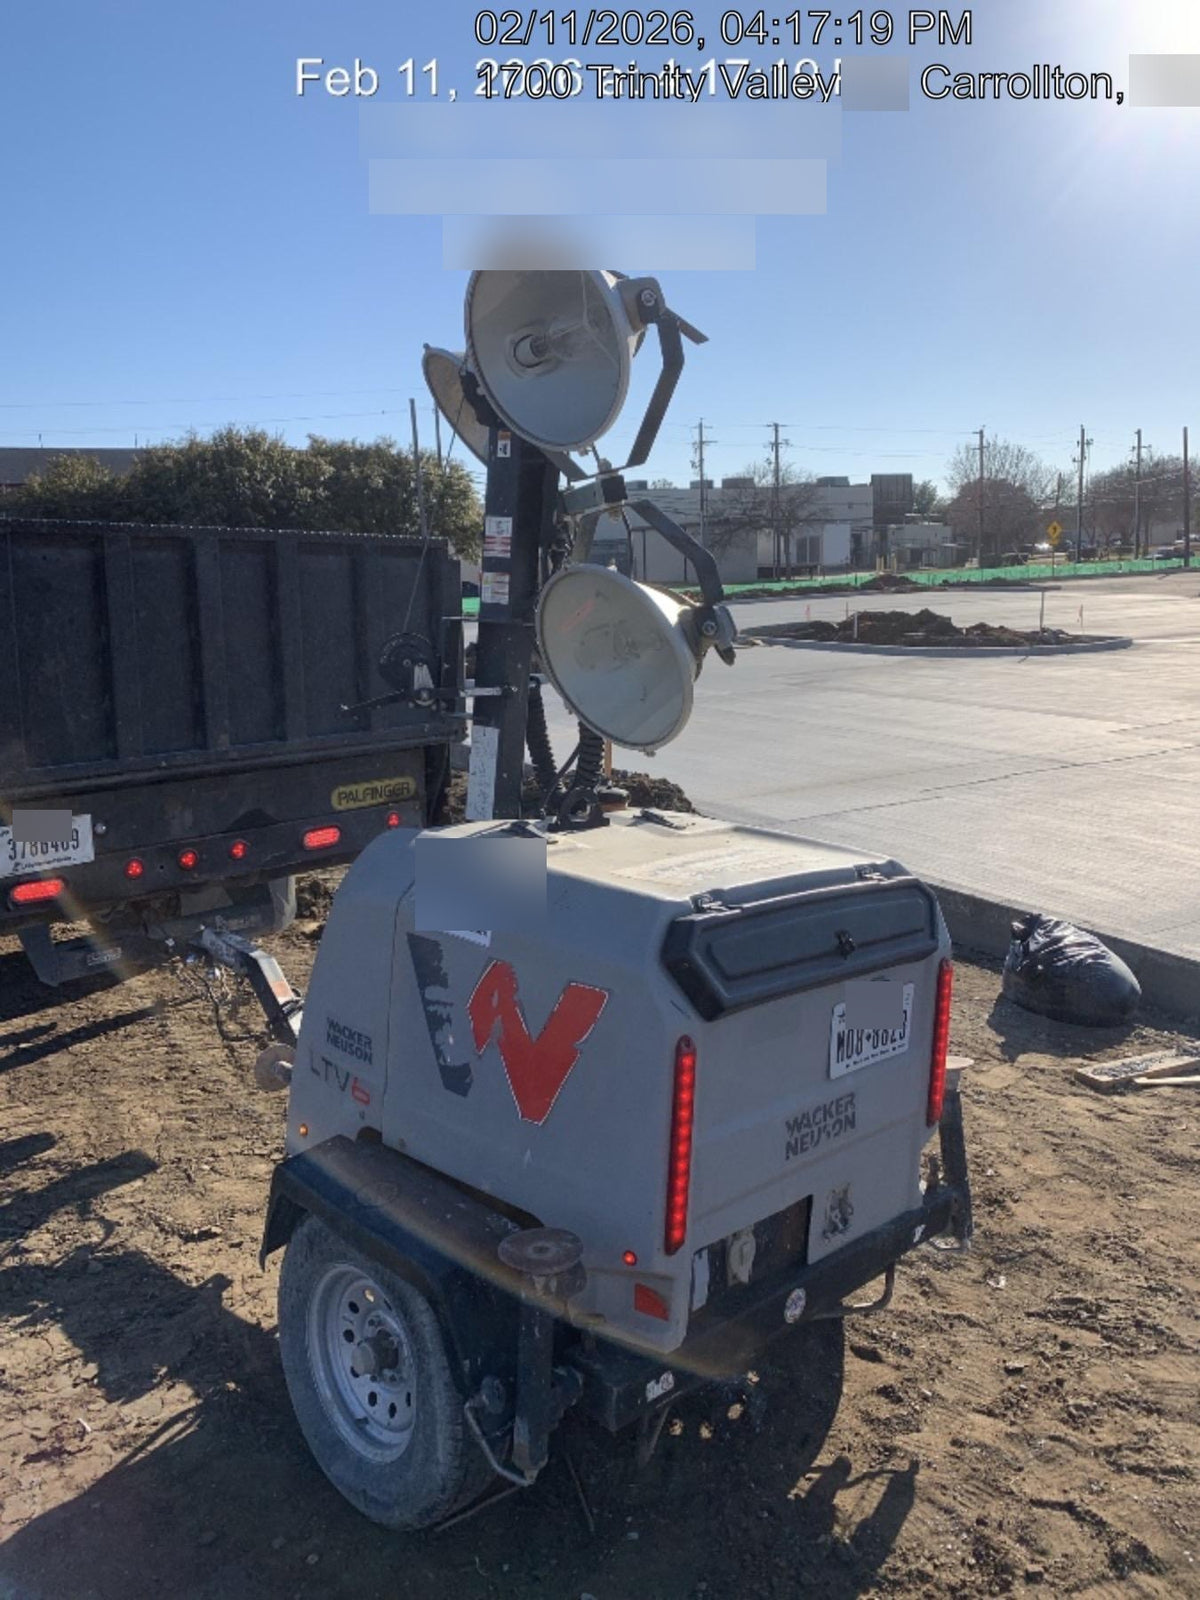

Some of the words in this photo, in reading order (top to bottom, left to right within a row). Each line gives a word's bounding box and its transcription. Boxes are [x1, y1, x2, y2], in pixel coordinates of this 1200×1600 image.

[337, 782, 411, 807] PALFINGER
[326, 1017, 373, 1051] WACKER
[326, 1032, 373, 1065] NEUSON
[785, 1092, 856, 1138] WACKER
[785, 1110, 856, 1160] NEUSON
